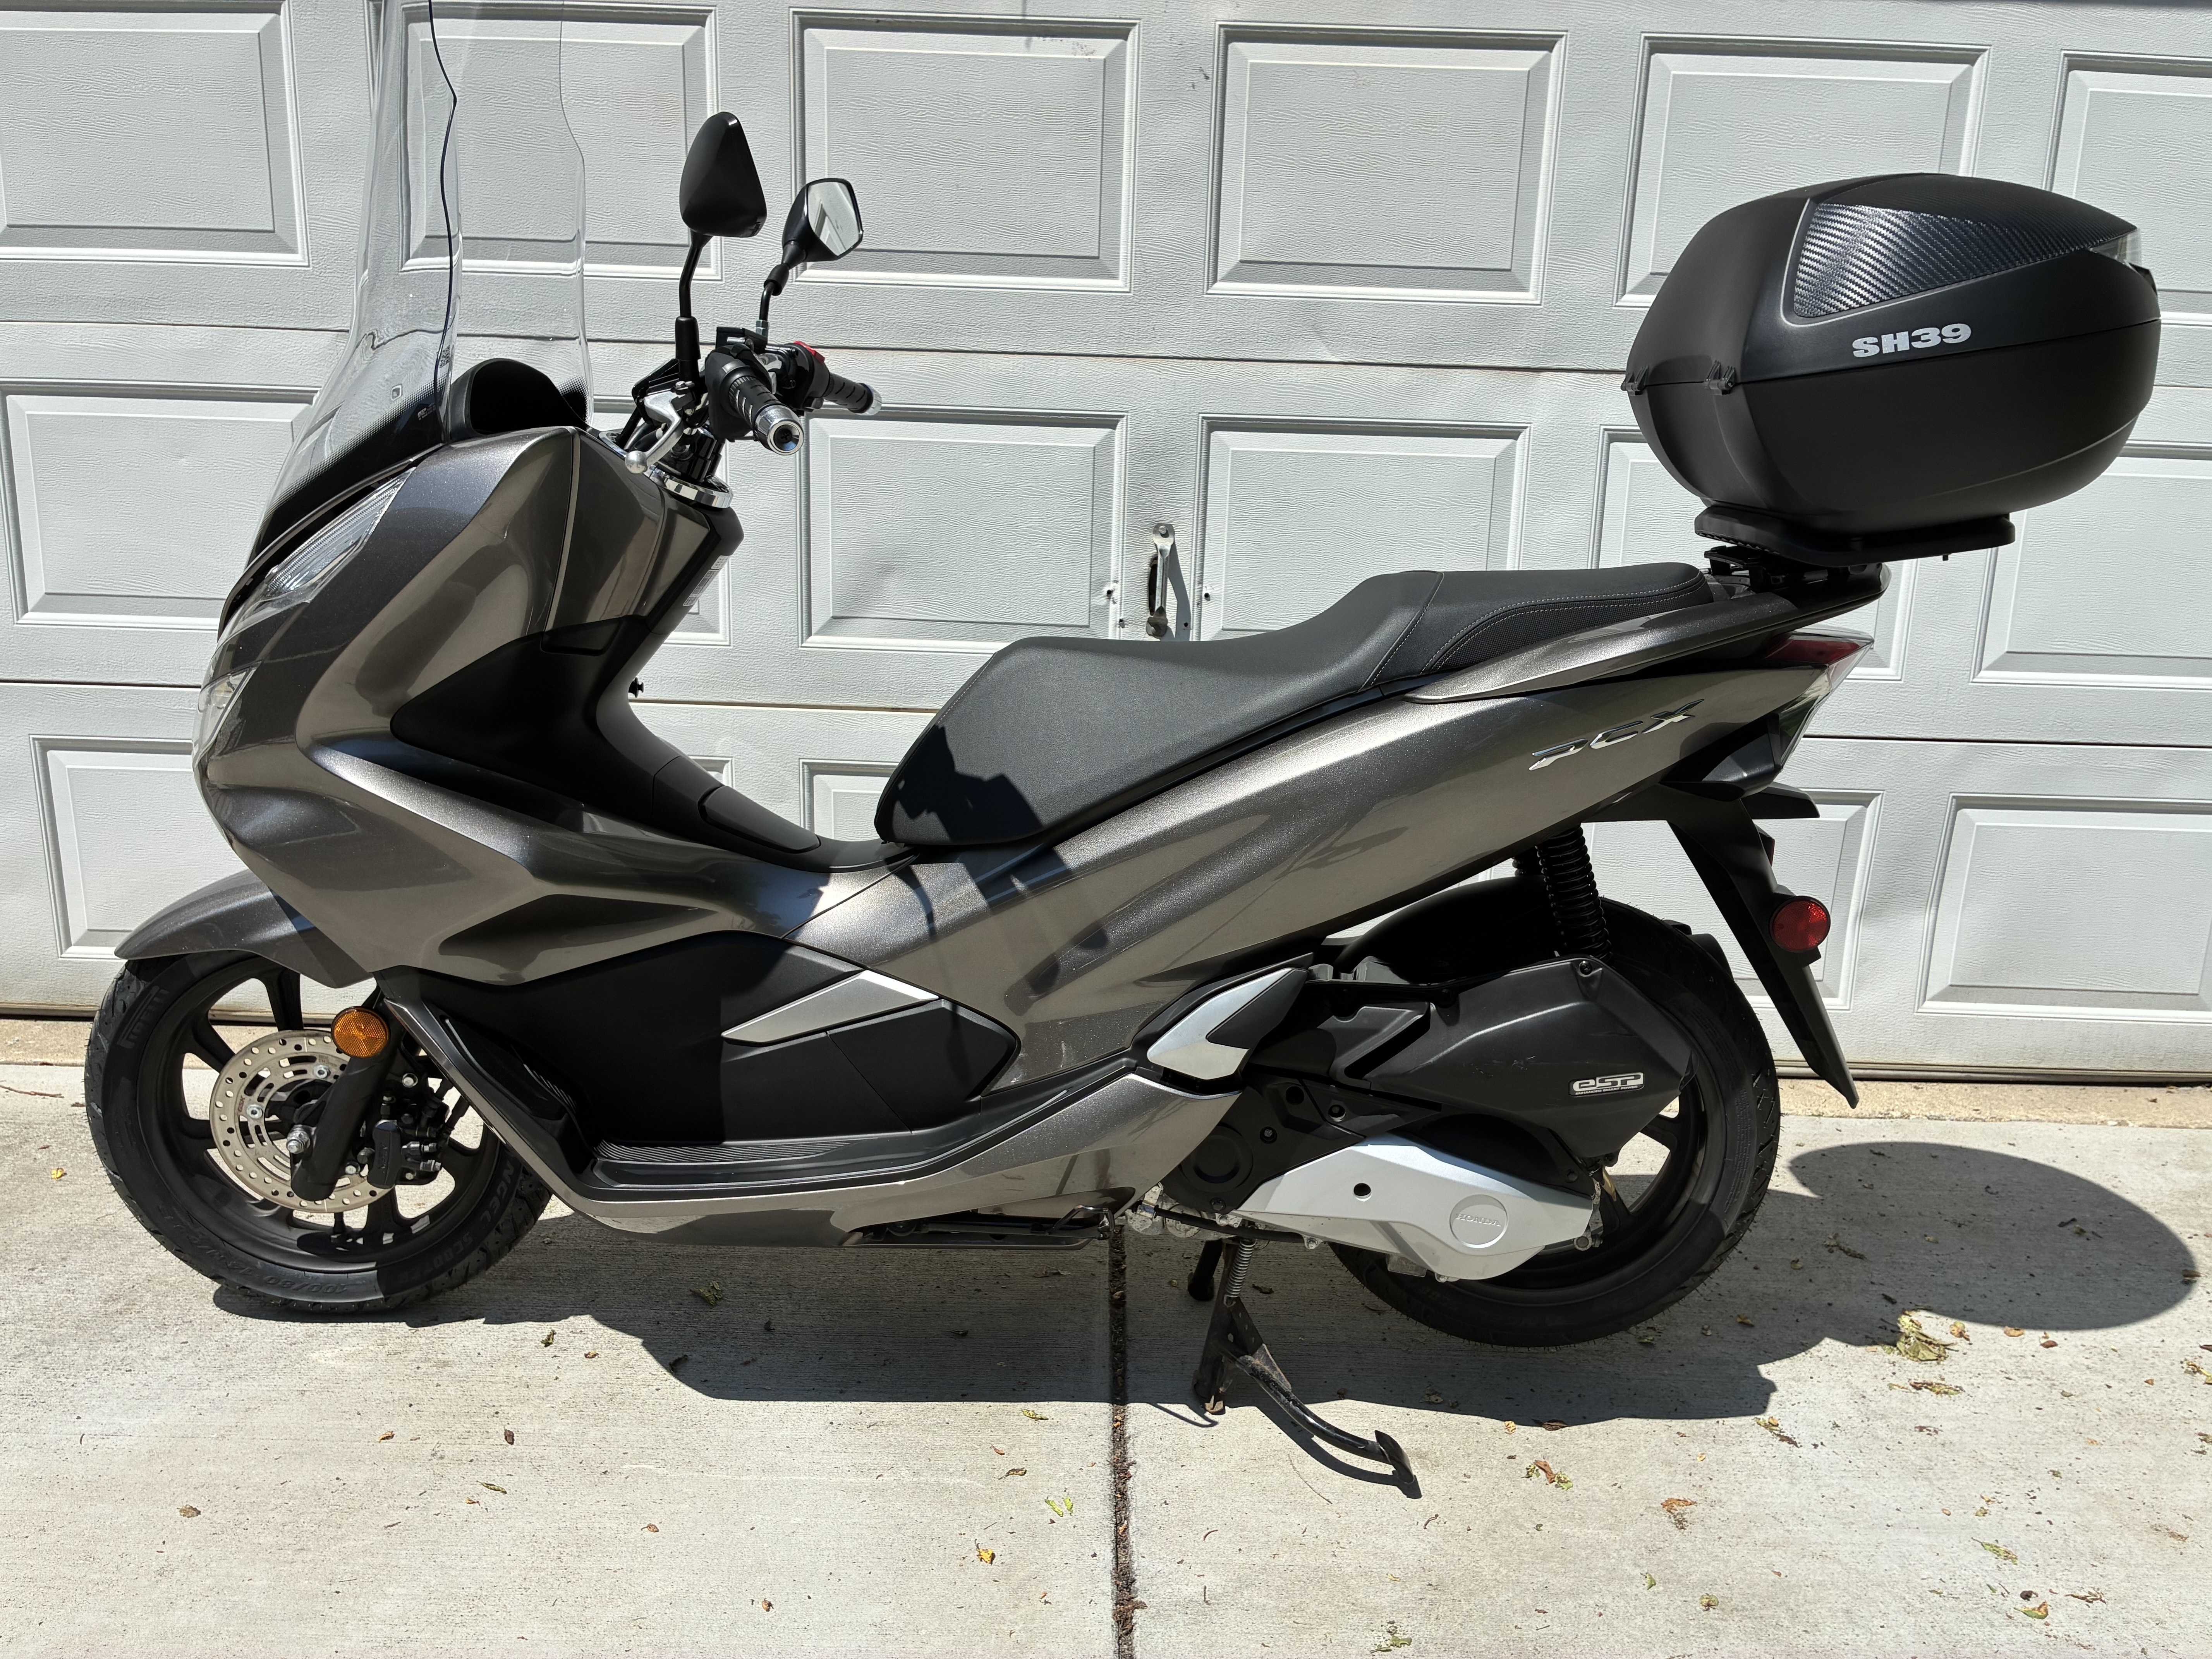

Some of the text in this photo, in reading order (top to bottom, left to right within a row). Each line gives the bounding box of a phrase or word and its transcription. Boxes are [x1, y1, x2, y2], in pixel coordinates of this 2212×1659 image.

[1852, 323, 1971, 357] SH39
[1529, 698, 1704, 771] PCX
[1456, 1213, 1501, 1226] HONDA
